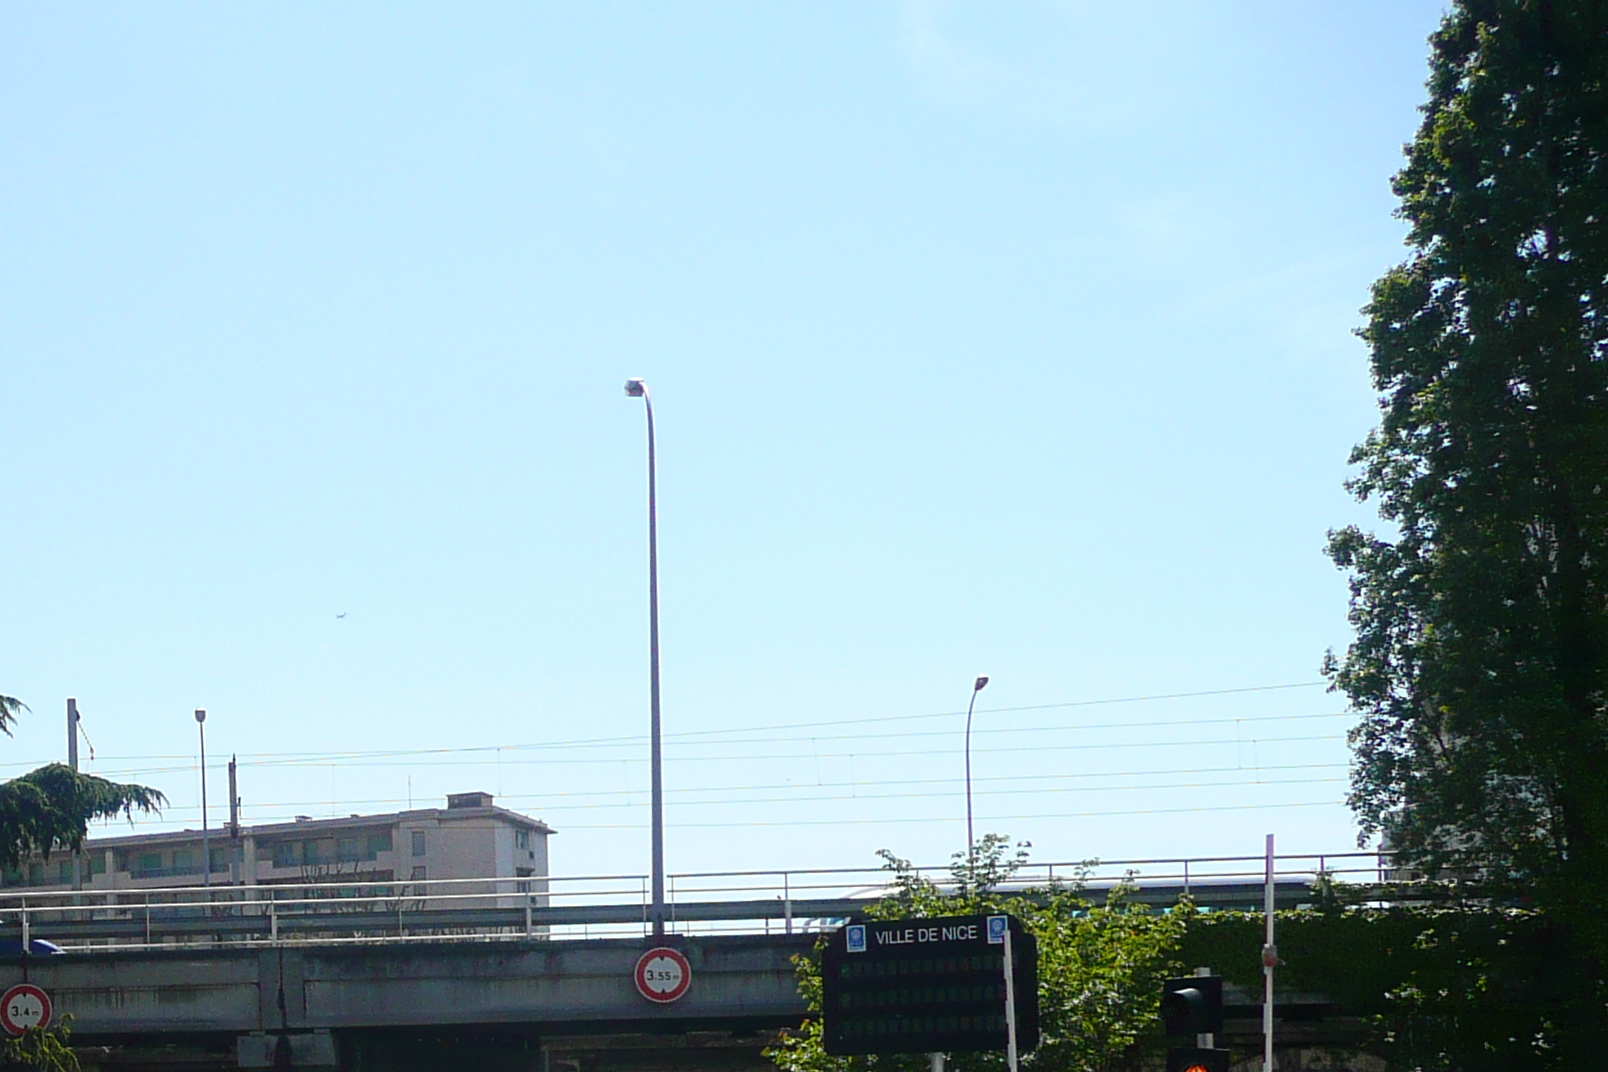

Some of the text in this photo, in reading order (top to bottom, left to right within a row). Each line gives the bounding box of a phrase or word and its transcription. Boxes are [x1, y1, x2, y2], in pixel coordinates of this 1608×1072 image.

[875, 929, 915, 945] VILLE
[918, 927, 938, 943] DE
[942, 925, 978, 941] NICE
